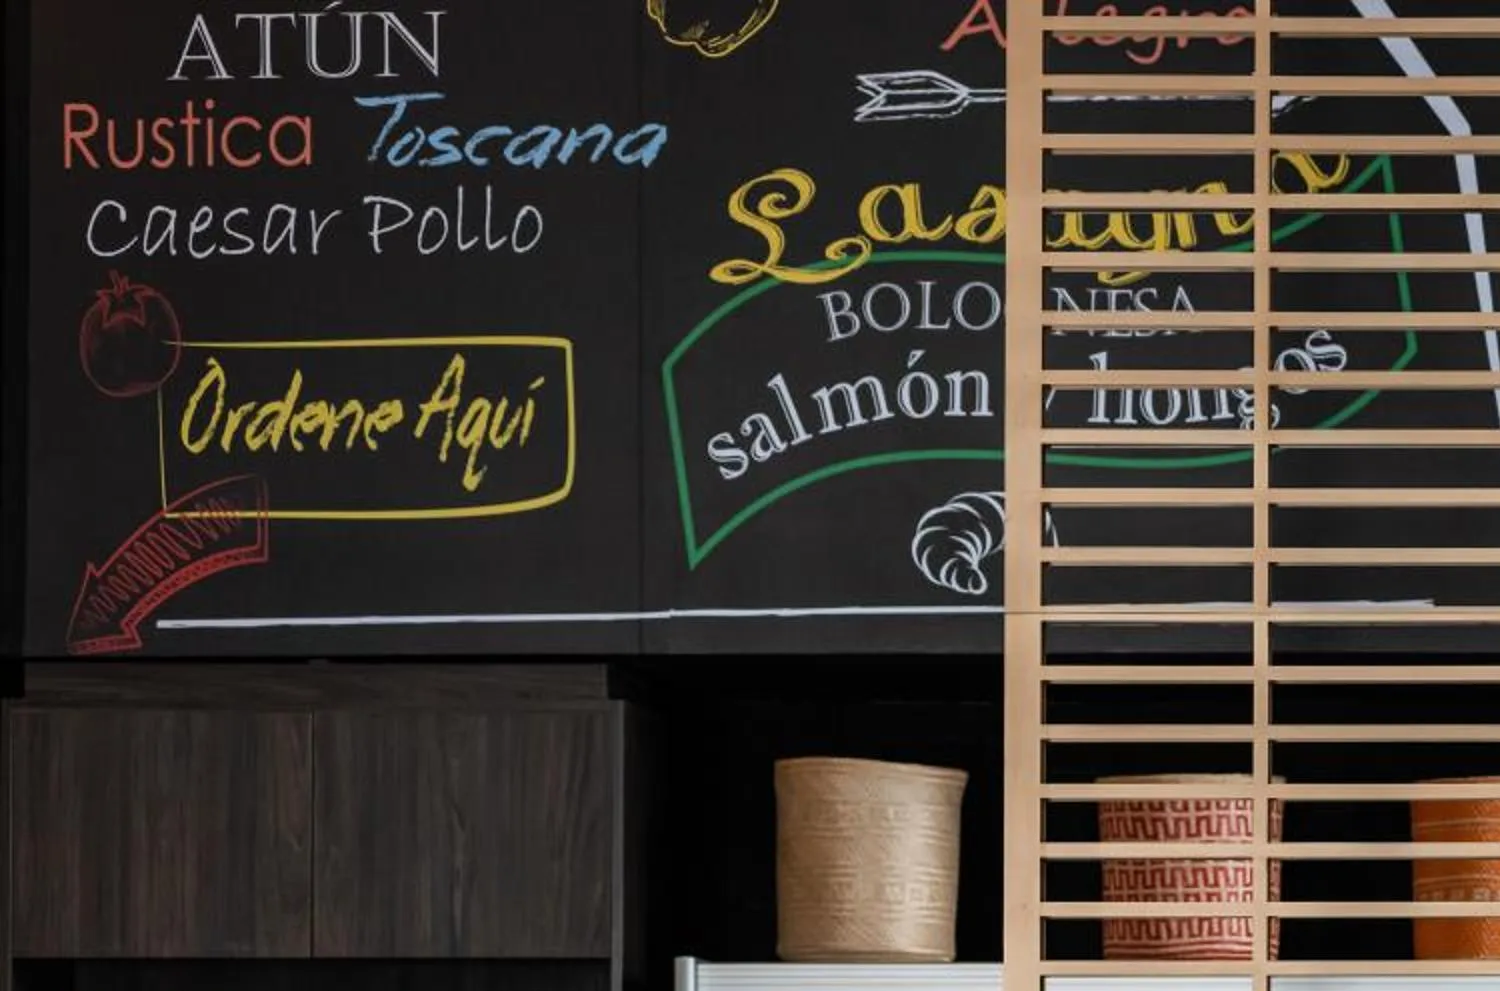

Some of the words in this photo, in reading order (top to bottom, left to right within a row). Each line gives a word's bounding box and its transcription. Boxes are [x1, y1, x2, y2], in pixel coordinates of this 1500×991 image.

[168, 1, 445, 80] ATÚN
[63, 100, 311, 169] Rustica
[354, 93, 668, 168] Toscana
[86, 200, 341, 258] Caesar
[363, 186, 543, 254] Pollo
[816, 281, 1202, 342] BOLONESA
[181, 357, 403, 453] Ordene
[414, 354, 545, 491] Aquí
[707, 350, 994, 480] salmón
